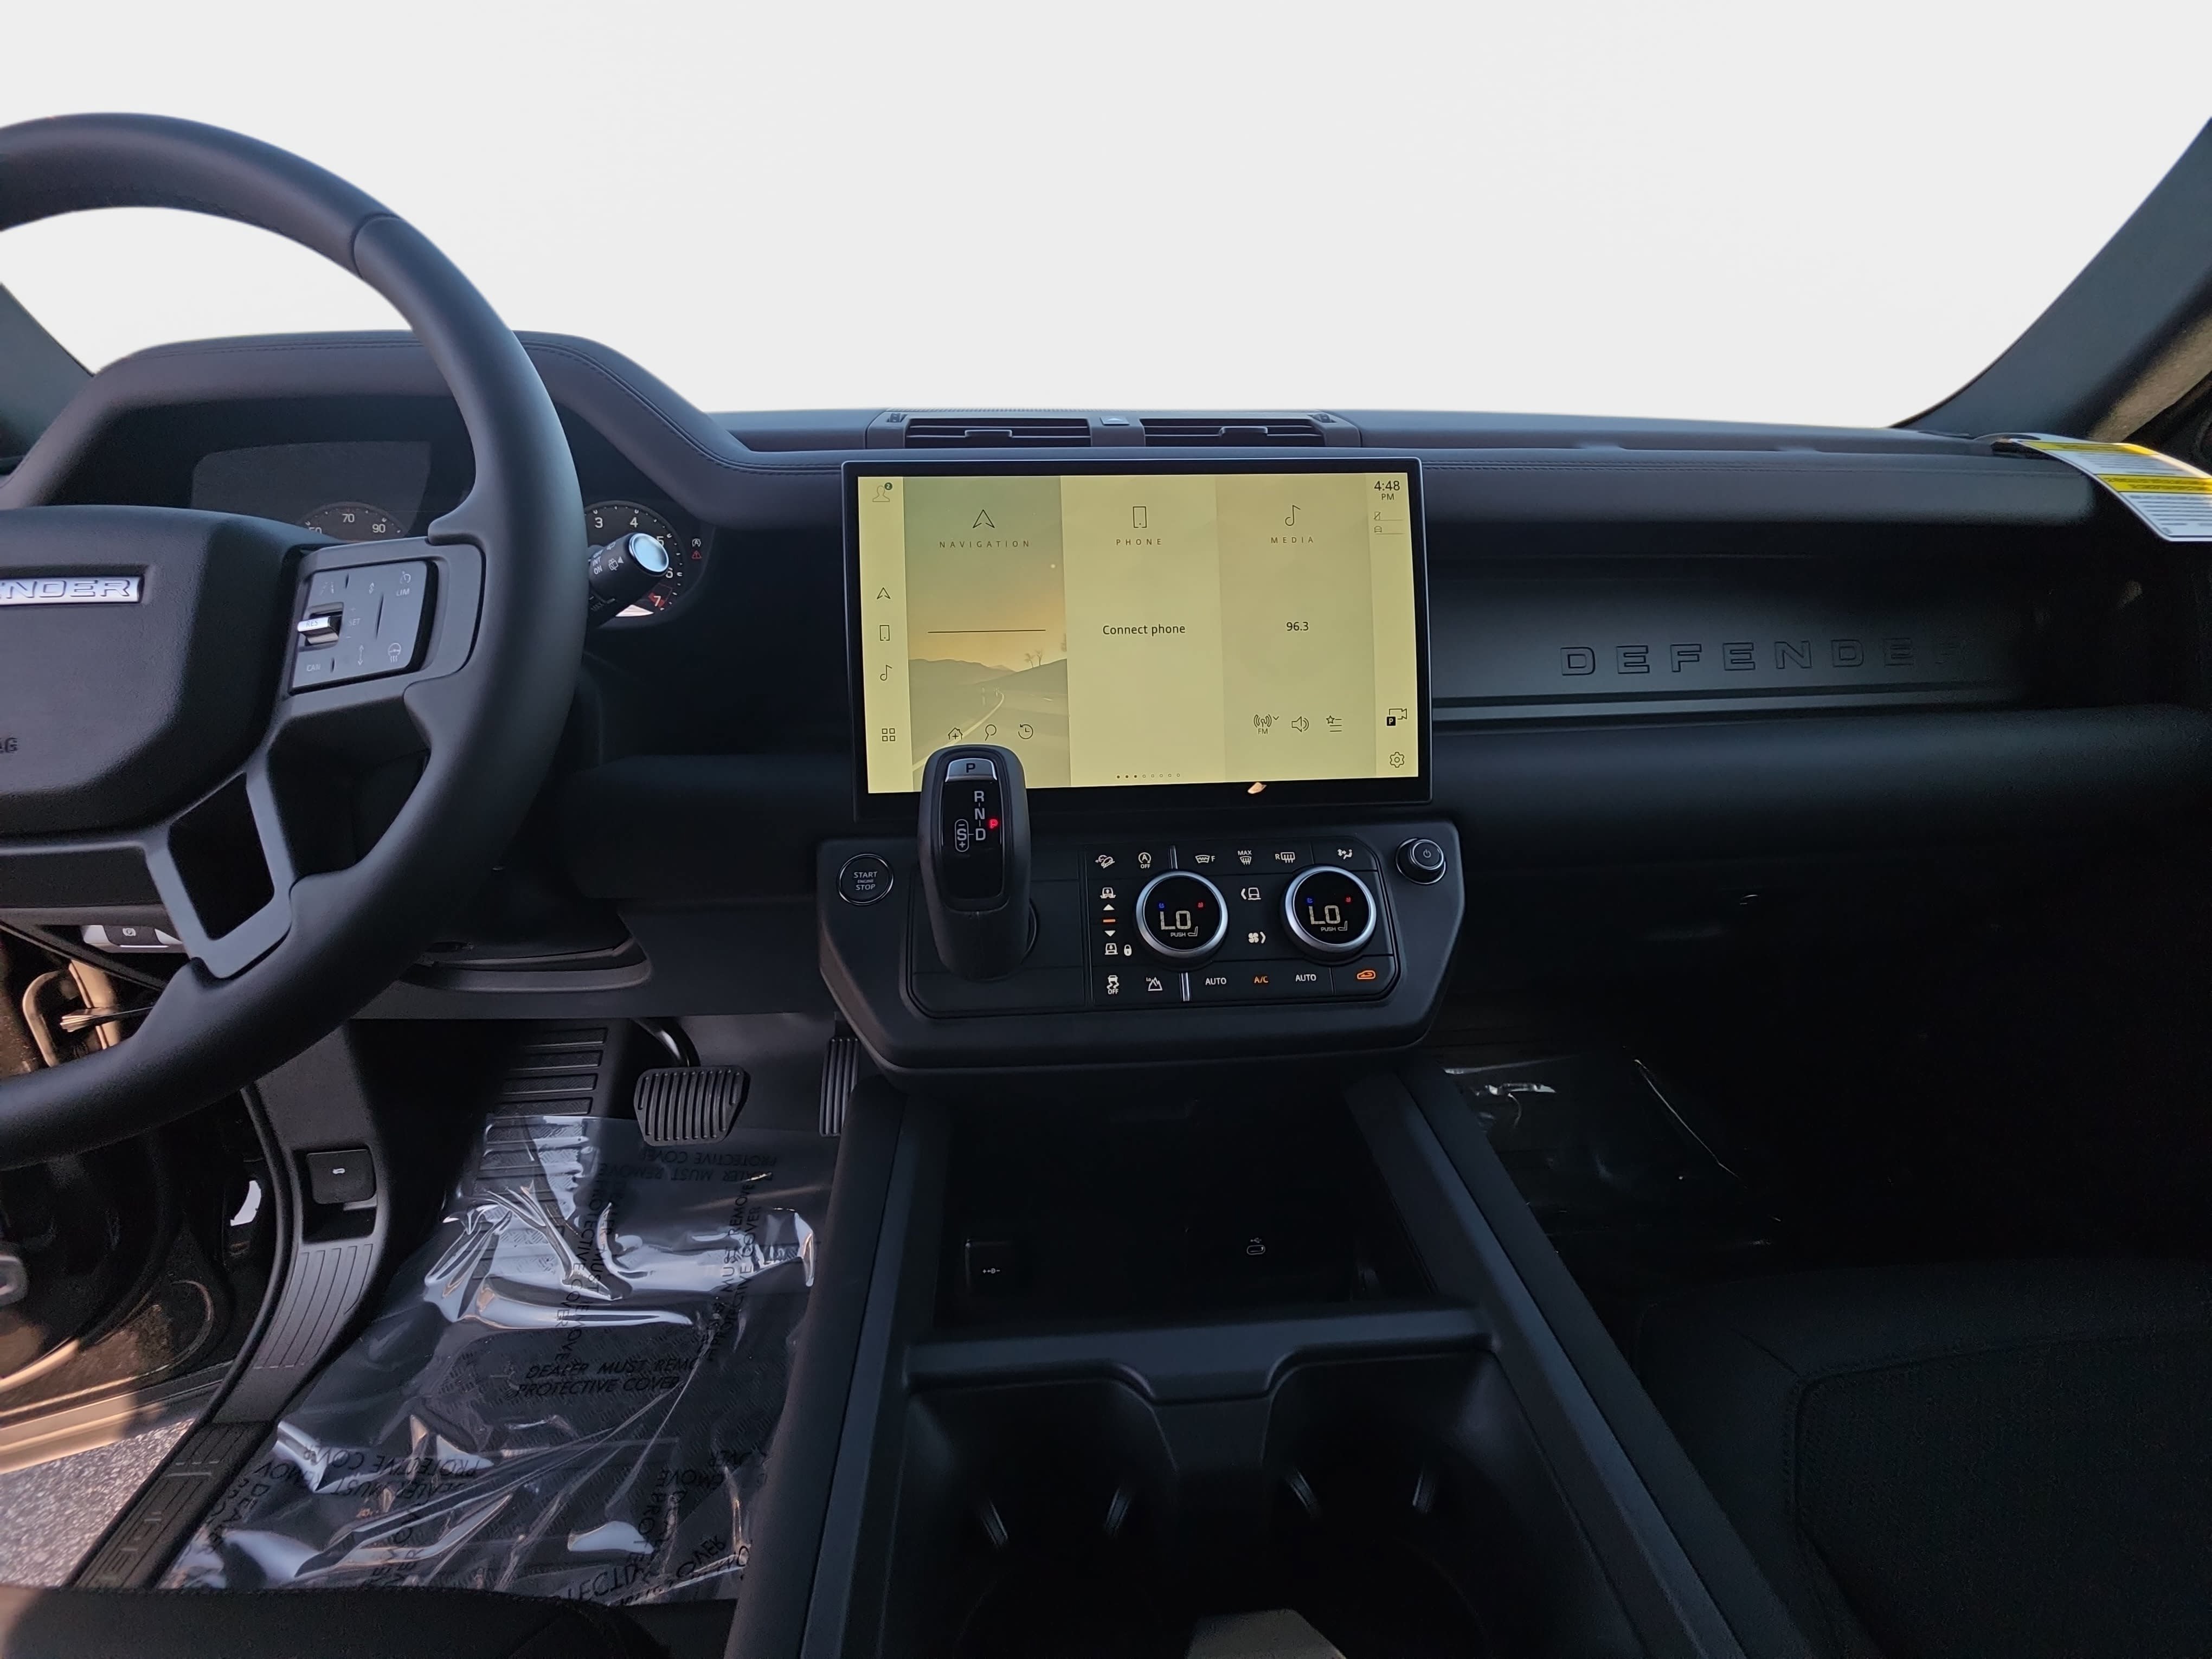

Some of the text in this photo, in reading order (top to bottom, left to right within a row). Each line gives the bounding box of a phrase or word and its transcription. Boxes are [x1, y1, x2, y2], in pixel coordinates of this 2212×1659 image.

[1373, 480, 1400, 491] 4:48
[342, 513, 355, 523] 70
[595, 517, 603, 528] 3
[629, 517, 639, 528] 4
[372, 523, 386, 533] 90
[939, 540, 1030, 549] NAVIGATION
[594, 565, 603, 575] ON
[0, 578, 131, 600] NDER
[396, 588, 410, 596] LIM
[653, 595, 661, 607] 7
[306, 620, 319, 628] RES
[1102, 623, 1186, 636] Connect phone
[1285, 621, 1309, 632] 96.3
[306, 663, 321, 672] CAN
[966, 763, 976, 773] P
[974, 790, 985, 802] R
[975, 808, 985, 820] N
[989, 819, 999, 829] P
[957, 828, 967, 841] S
[975, 828, 986, 841] D
[1159, 910, 1192, 930] LO
[1308, 905, 1341, 925] LO
[1205, 977, 1227, 986] AUTO
[1253, 975, 1269, 984] A/C
[1295, 974, 1317, 982] AUTO
